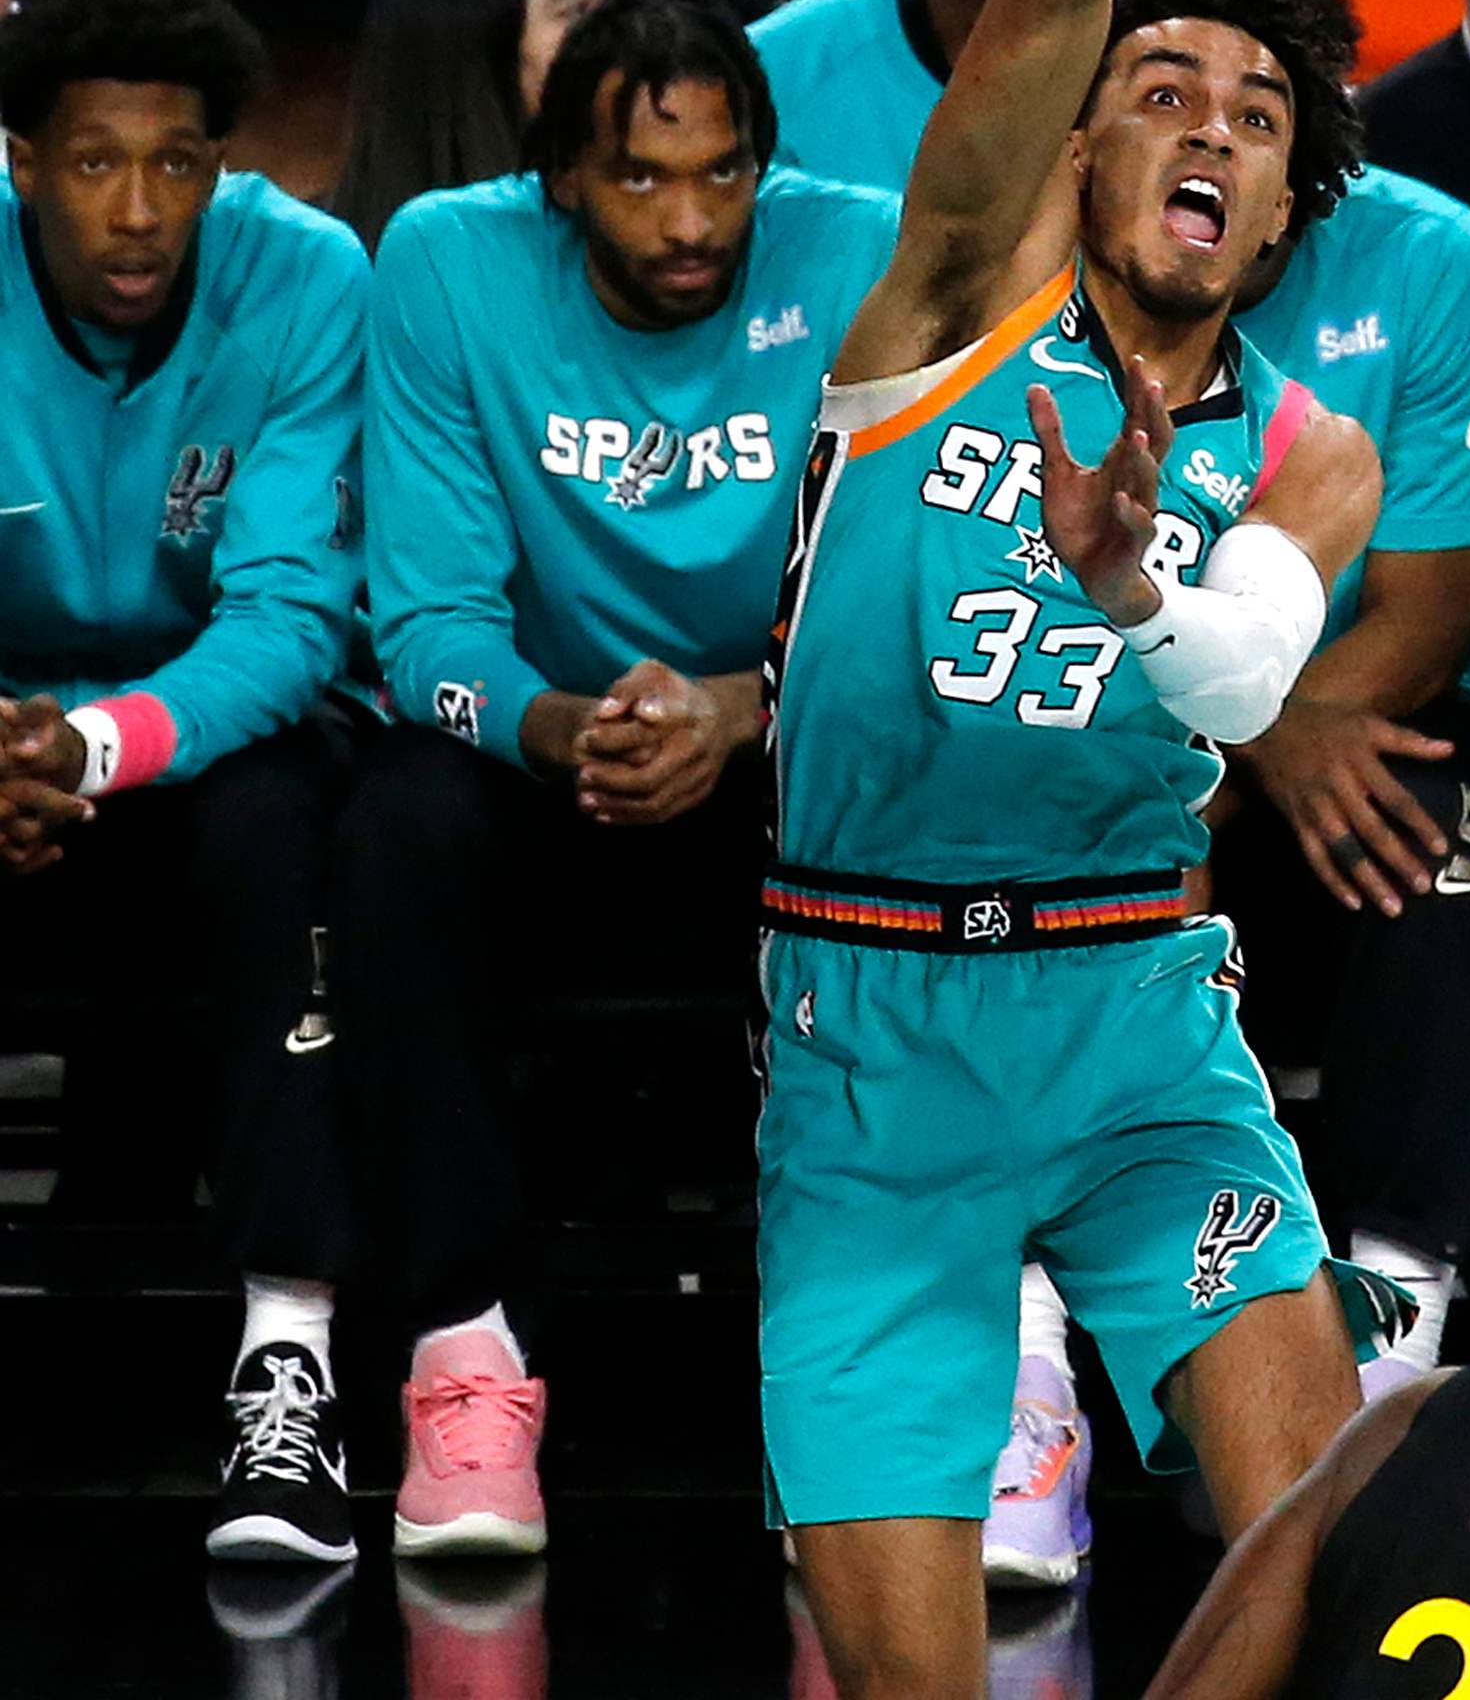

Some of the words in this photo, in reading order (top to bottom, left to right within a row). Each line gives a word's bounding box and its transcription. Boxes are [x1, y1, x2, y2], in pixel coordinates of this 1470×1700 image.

[1316, 315, 1387, 363] Self.
[540, 413, 777, 510] SPURS
[1182, 448, 1250, 518] Self.
[929, 587, 1126, 729] 33
[964, 901, 1010, 940] SA
